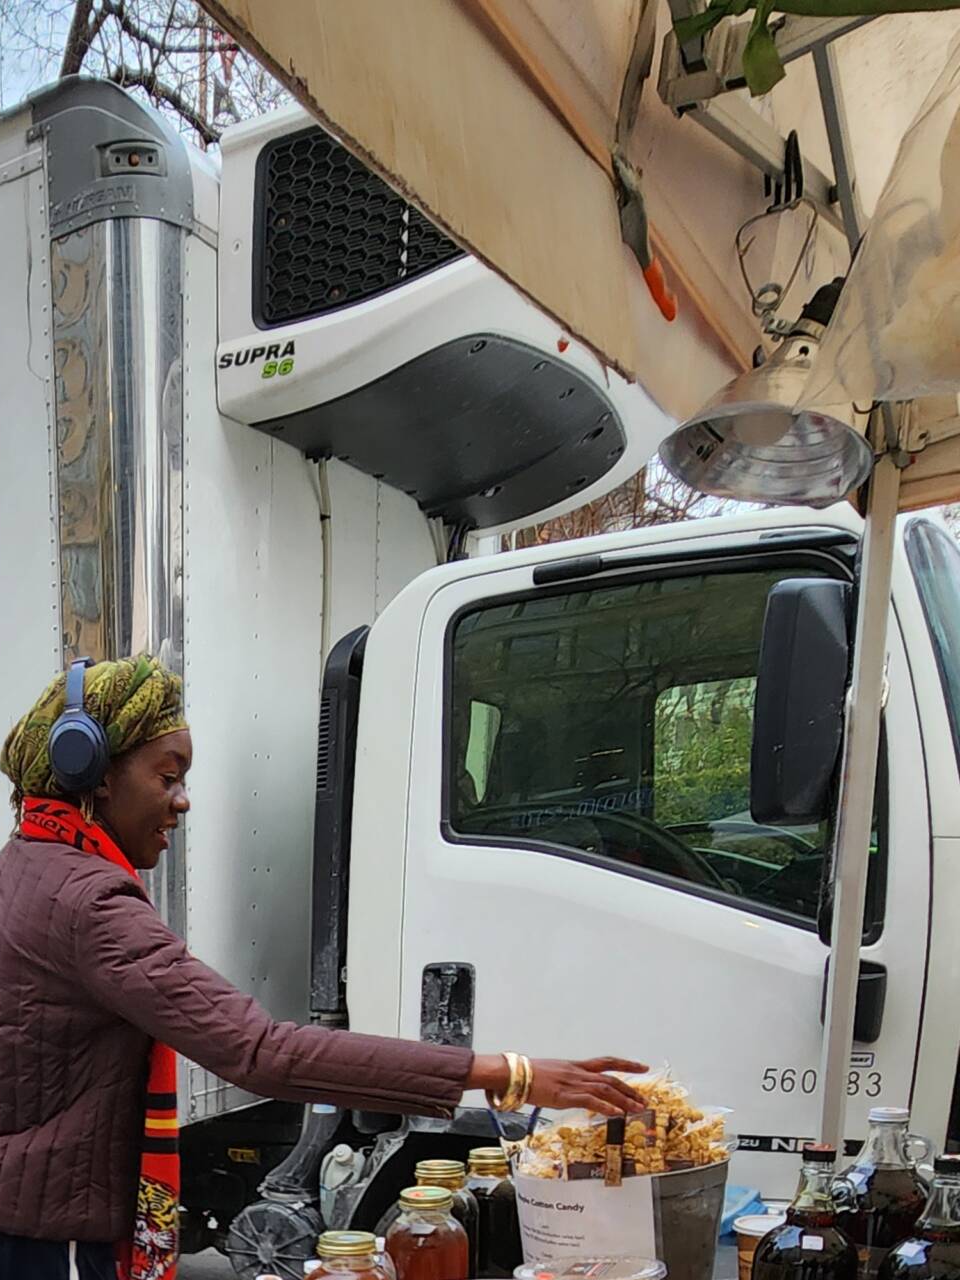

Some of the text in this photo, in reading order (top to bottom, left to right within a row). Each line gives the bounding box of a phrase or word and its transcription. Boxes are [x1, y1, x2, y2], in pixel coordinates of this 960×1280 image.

[219, 341, 295, 369] SUPRA
[761, 1067, 882, 1098] 56083
[556, 1202, 585, 1214] Candy
